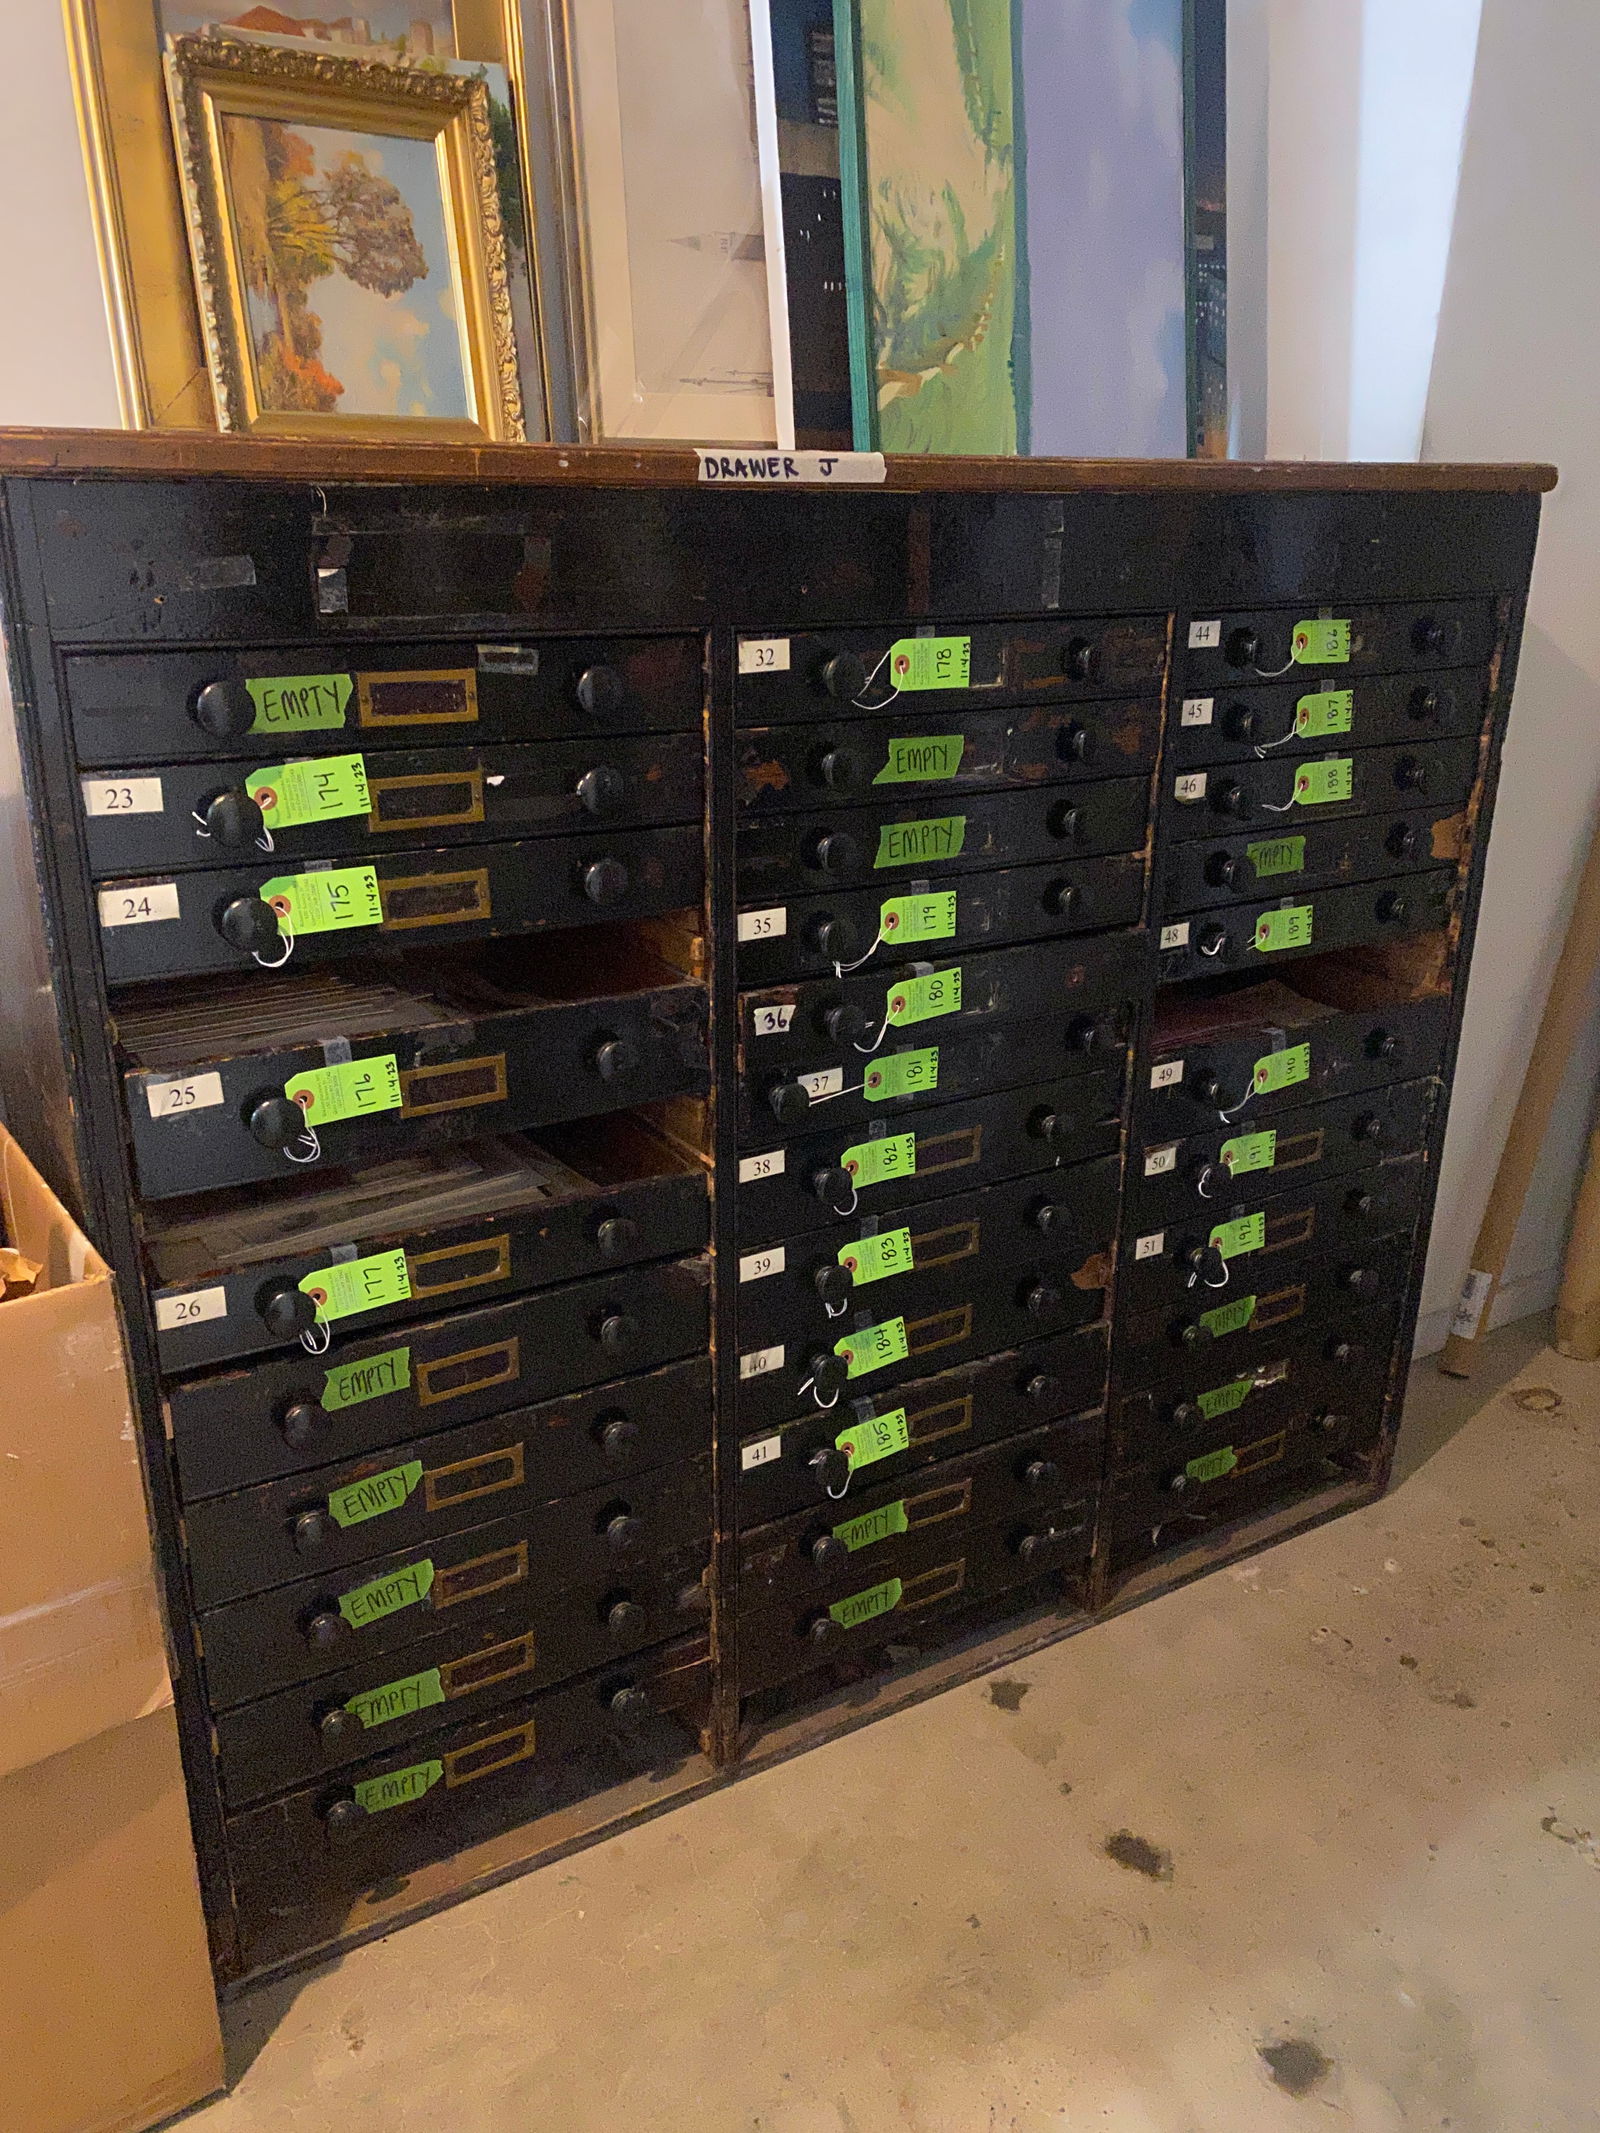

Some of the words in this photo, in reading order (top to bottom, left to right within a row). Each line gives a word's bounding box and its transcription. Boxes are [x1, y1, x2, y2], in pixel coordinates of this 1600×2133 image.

[705, 457, 799, 478] DRAWER
[819, 458, 838, 476] J
[1195, 626, 1210, 641] 44
[755, 648, 774, 666] 32
[936, 648, 952, 679] 178
[263, 680, 340, 722] EMPTY
[1188, 704, 1202, 718] 45
[896, 744, 948, 774] EMPTY
[313, 772, 343, 810] 174
[1181, 779, 1196, 792] 46
[105, 788, 133, 809] 23
[888, 820, 953, 858] EMPTY
[122, 897, 152, 919] 24
[327, 882, 354, 919] 175
[753, 918, 771, 935] 35
[923, 906, 937, 930] 179
[1164, 928, 1178, 943] 48
[929, 980, 944, 1009] 180
[763, 1008, 788, 1031] 36
[812, 1076, 829, 1093] 37
[906, 1061, 923, 1085] 181
[1159, 1068, 1173, 1081] 49
[169, 1086, 196, 1107] 25
[355, 1073, 376, 1108] 176
[753, 1159, 771, 1176] 38
[882, 1142, 898, 1172] 182
[1152, 1156, 1165, 1170] 50
[881, 1237, 899, 1268] 183
[1143, 1242, 1156, 1254] 51
[753, 1258, 771, 1275] 39
[363, 1267, 385, 1301] 177
[175, 1298, 201, 1320] 26
[873, 1328, 894, 1359] 184
[340, 1357, 397, 1400] EMPTY
[872, 1422, 894, 1452] 185
[751, 1446, 767, 1460] 41
[343, 1470, 409, 1518] EMPTY
[841, 1509, 888, 1544] EMPTY
[351, 1571, 421, 1619] EMPTY
[842, 1585, 889, 1623] EMPTY
[355, 1681, 420, 1726] EMPTY
[365, 1767, 430, 1806] EMPTY
